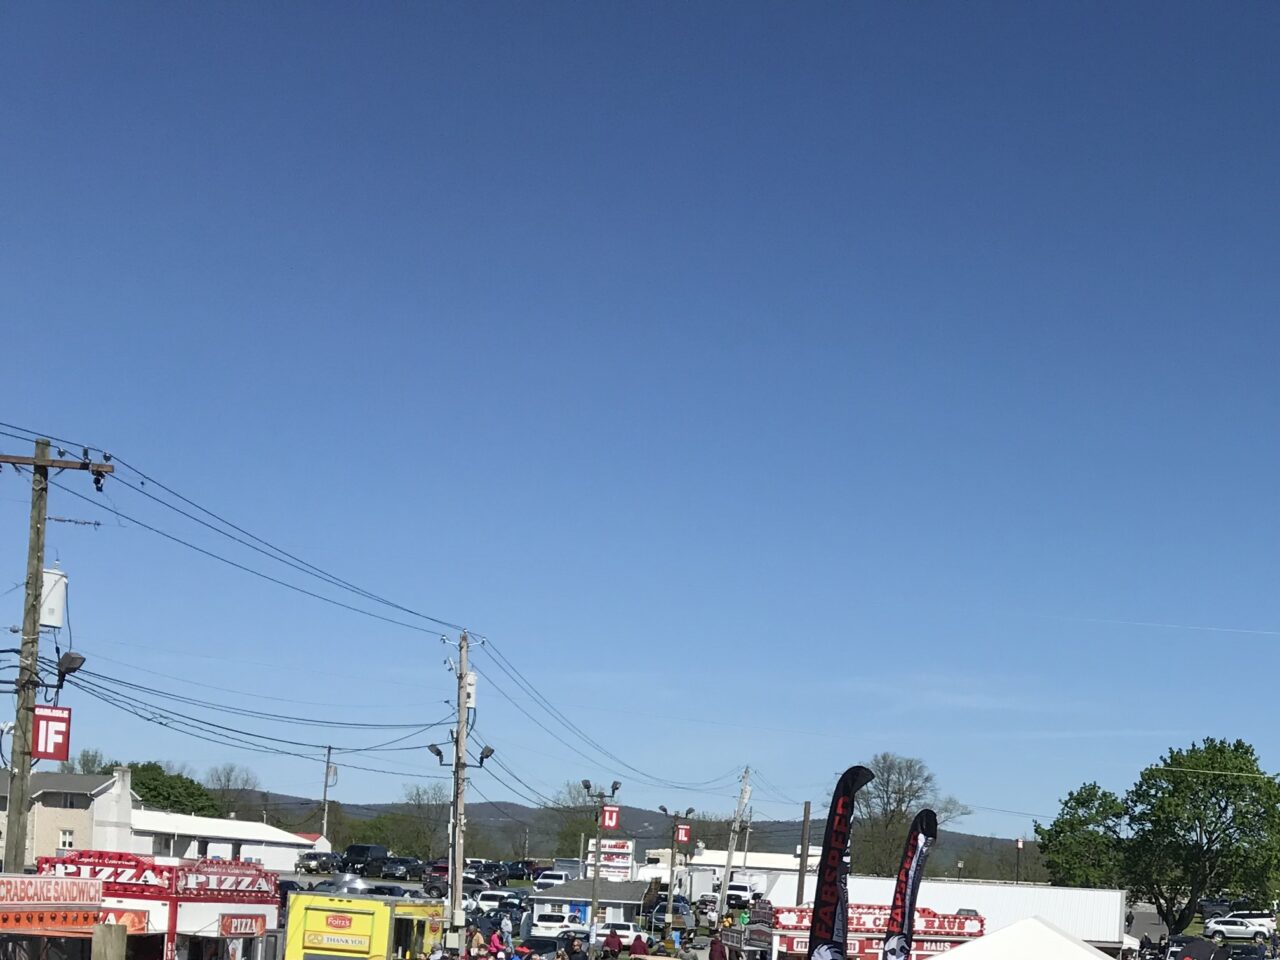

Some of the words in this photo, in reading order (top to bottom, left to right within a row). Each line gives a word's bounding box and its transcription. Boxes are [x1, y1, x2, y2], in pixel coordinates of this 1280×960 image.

[38, 720, 66, 753] IF
[605, 811, 617, 827] IJ
[678, 828, 688, 841] IL
[55, 863, 160, 886] PIZZA
[815, 795, 849, 941] FABSPEED
[184, 873, 270, 891] PIZZA
[0, 880, 52, 902] CRABCAKE
[54, 880, 100, 902] SANDWICH
[230, 918, 257, 933] PIZZA
[924, 919, 966, 931] HAUS
[326, 936, 348, 945] THANK
[350, 938, 365, 946] YOU
[923, 941, 951, 950] HAUS
